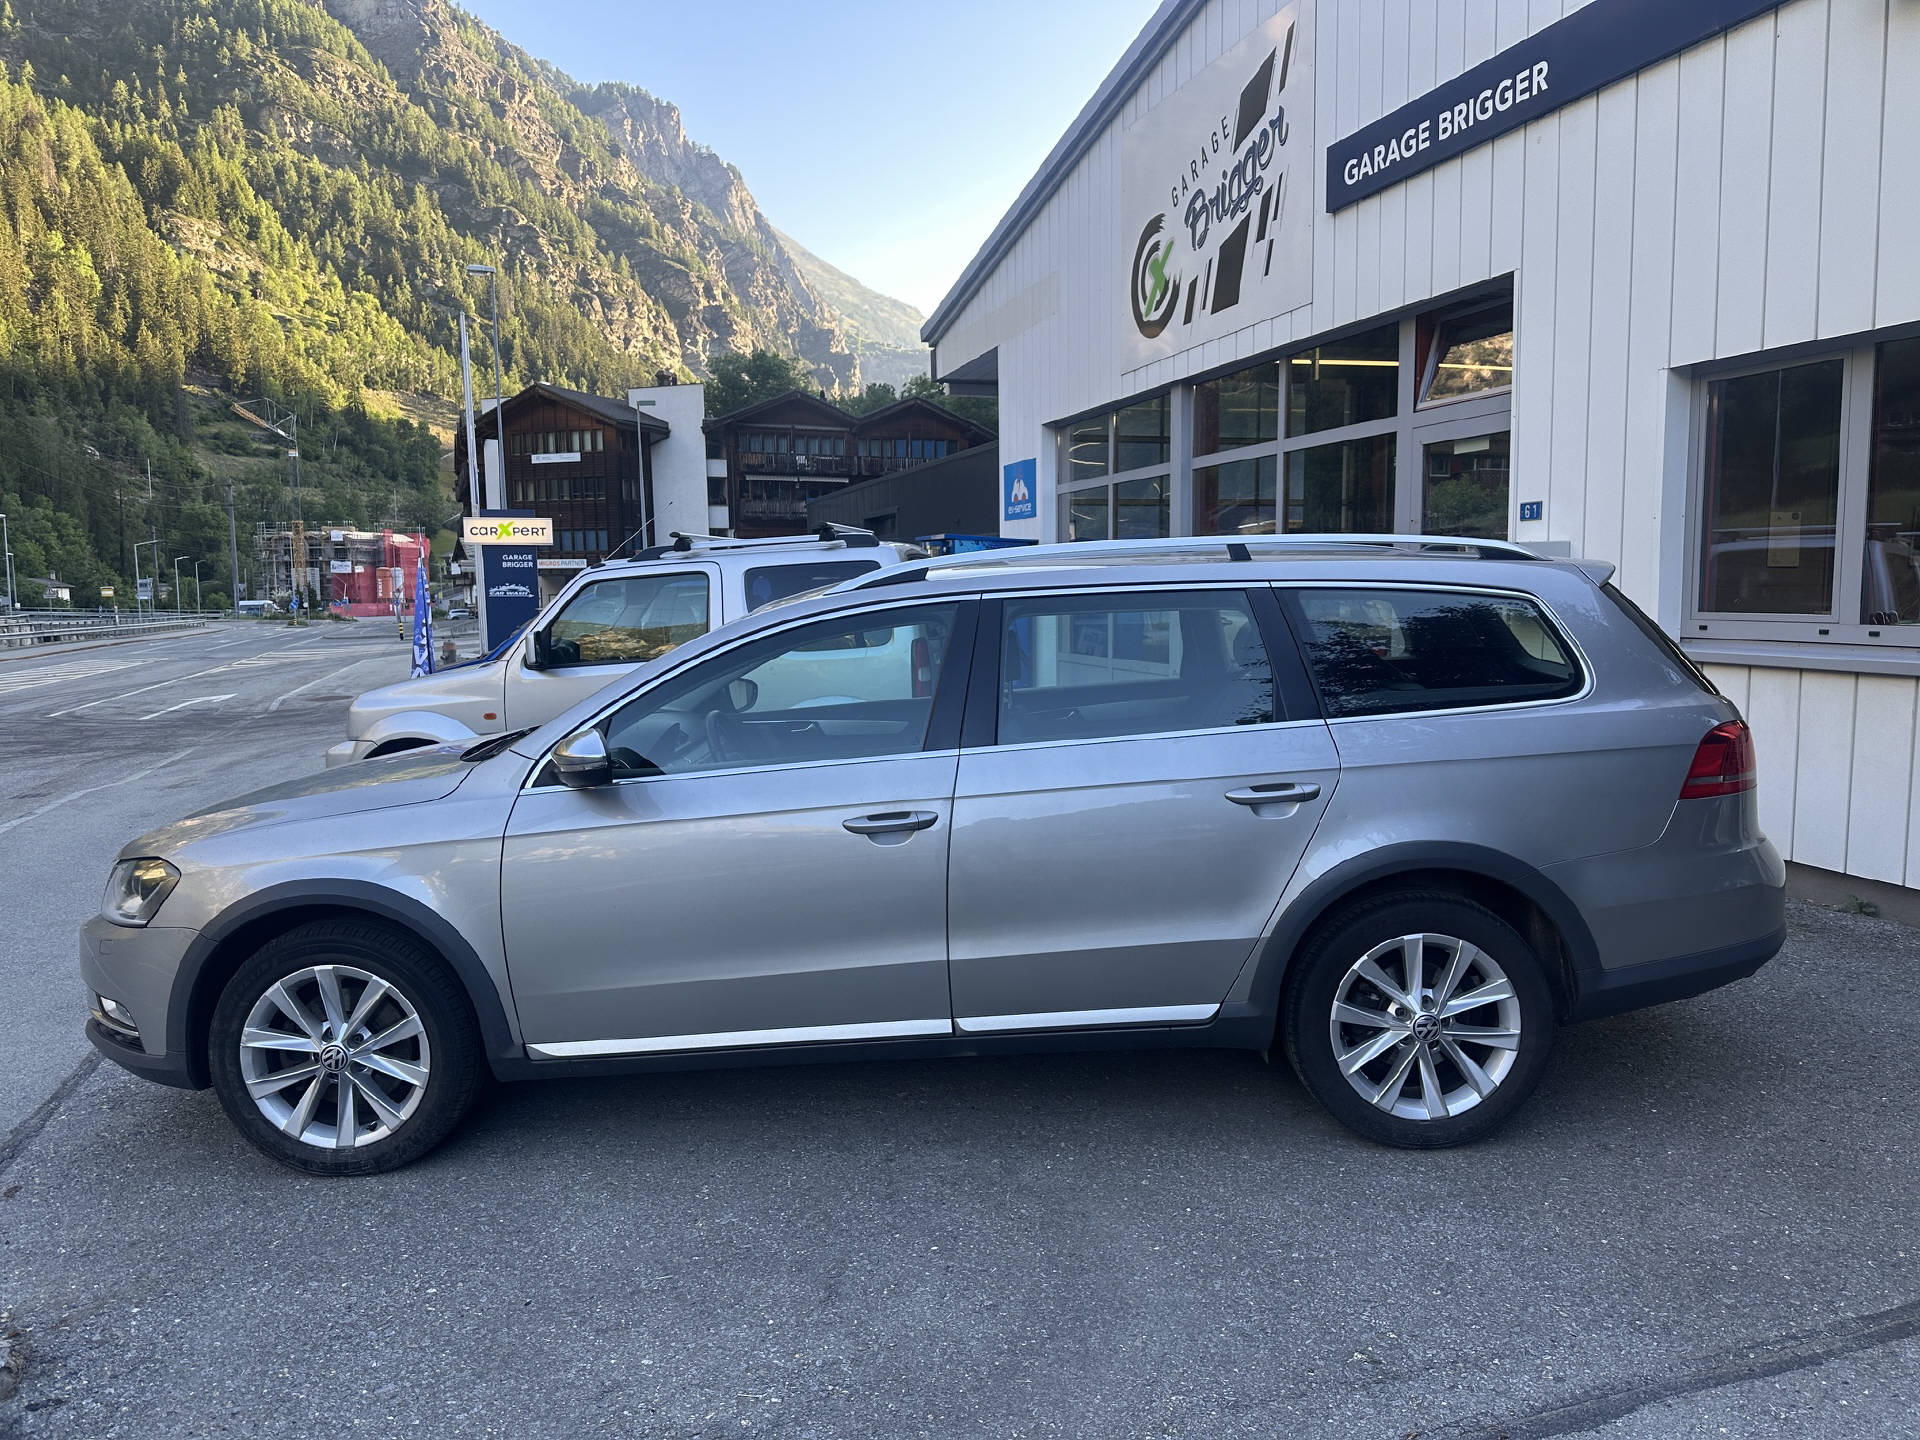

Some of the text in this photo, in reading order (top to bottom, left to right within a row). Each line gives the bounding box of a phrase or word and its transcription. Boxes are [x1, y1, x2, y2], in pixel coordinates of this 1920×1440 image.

[1171, 115, 1230, 208] GARAGE
[1343, 60, 1549, 186] GARAGE BRIGGER
[1184, 105, 1289, 251] Brigger
[1524, 503, 1537, 519] 61
